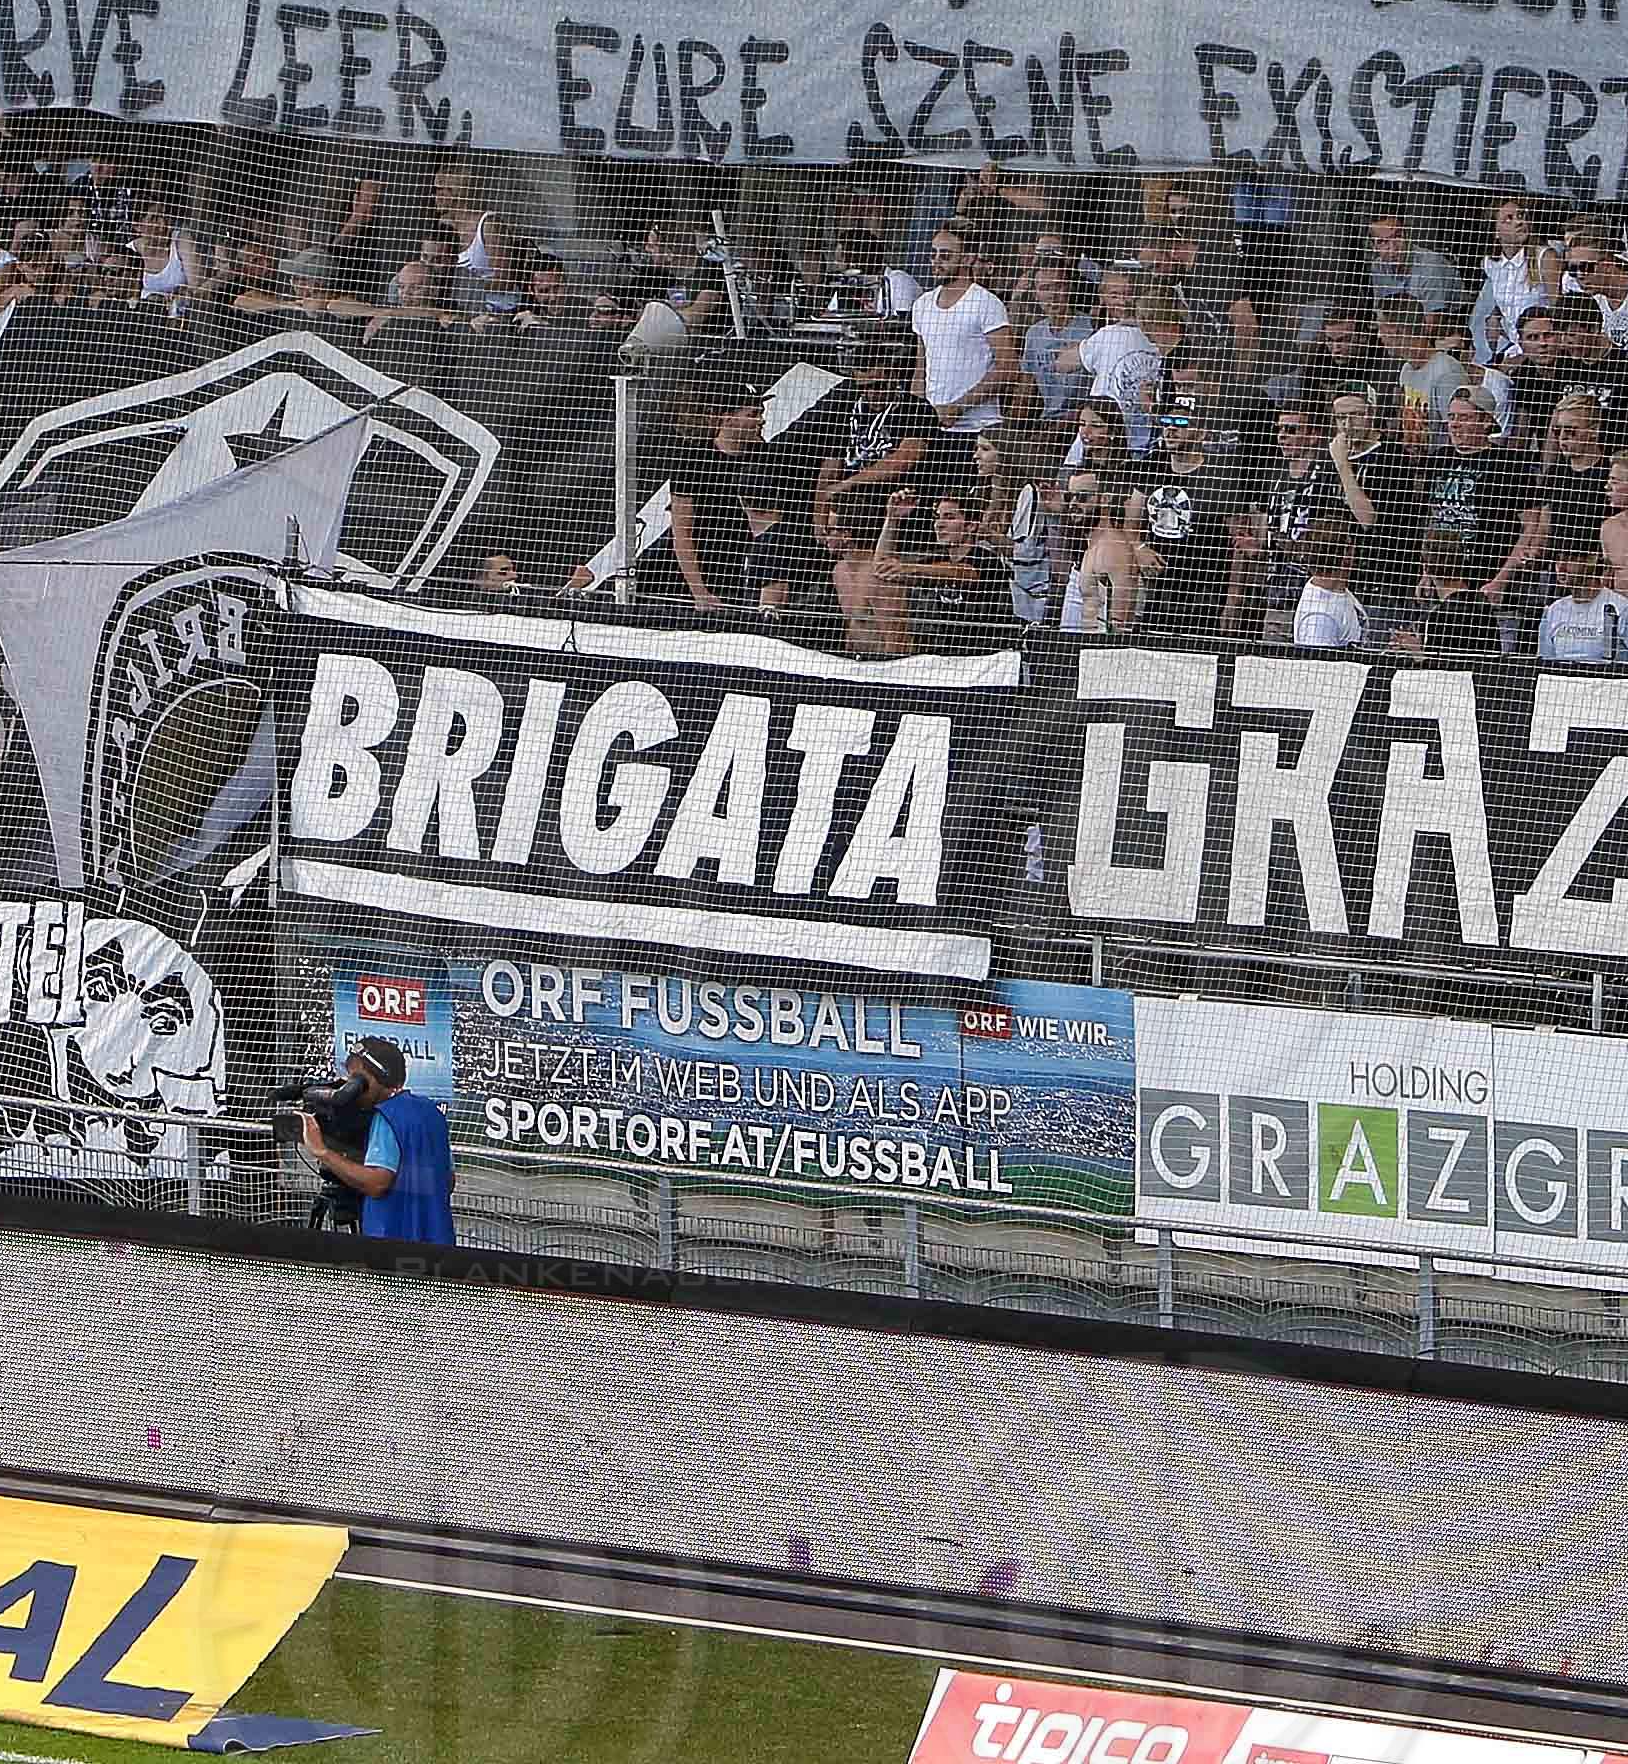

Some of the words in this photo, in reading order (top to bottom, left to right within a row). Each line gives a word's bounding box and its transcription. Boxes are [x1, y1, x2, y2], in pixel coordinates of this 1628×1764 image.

[555, 15, 794, 158] EURE
[846, 21, 1137, 167] SZENE
[289, 651, 953, 908] BRIGATA
[360, 986, 421, 1017] ORF
[481, 958, 605, 1022] ORF
[619, 972, 924, 1059] FUSSBALL
[962, 1009, 1011, 1036] ORF
[1017, 1015, 1061, 1042] WIE
[1066, 1020, 1116, 1047] WIR.
[482, 1039, 599, 1085] JETZT
[610, 1050, 642, 1087] IM
[654, 1058, 747, 1101] WEB
[754, 1066, 836, 1111] UND
[850, 1076, 921, 1122] ALS
[932, 1084, 1013, 1130] APP
[1350, 1061, 1490, 1106] HOLDING
[484, 1097, 1016, 1195] SPORTORF.AT/FUSSBALL
[1149, 1104, 1473, 1214] GRAZ
[972, 1682, 1189, 1764] tipico
